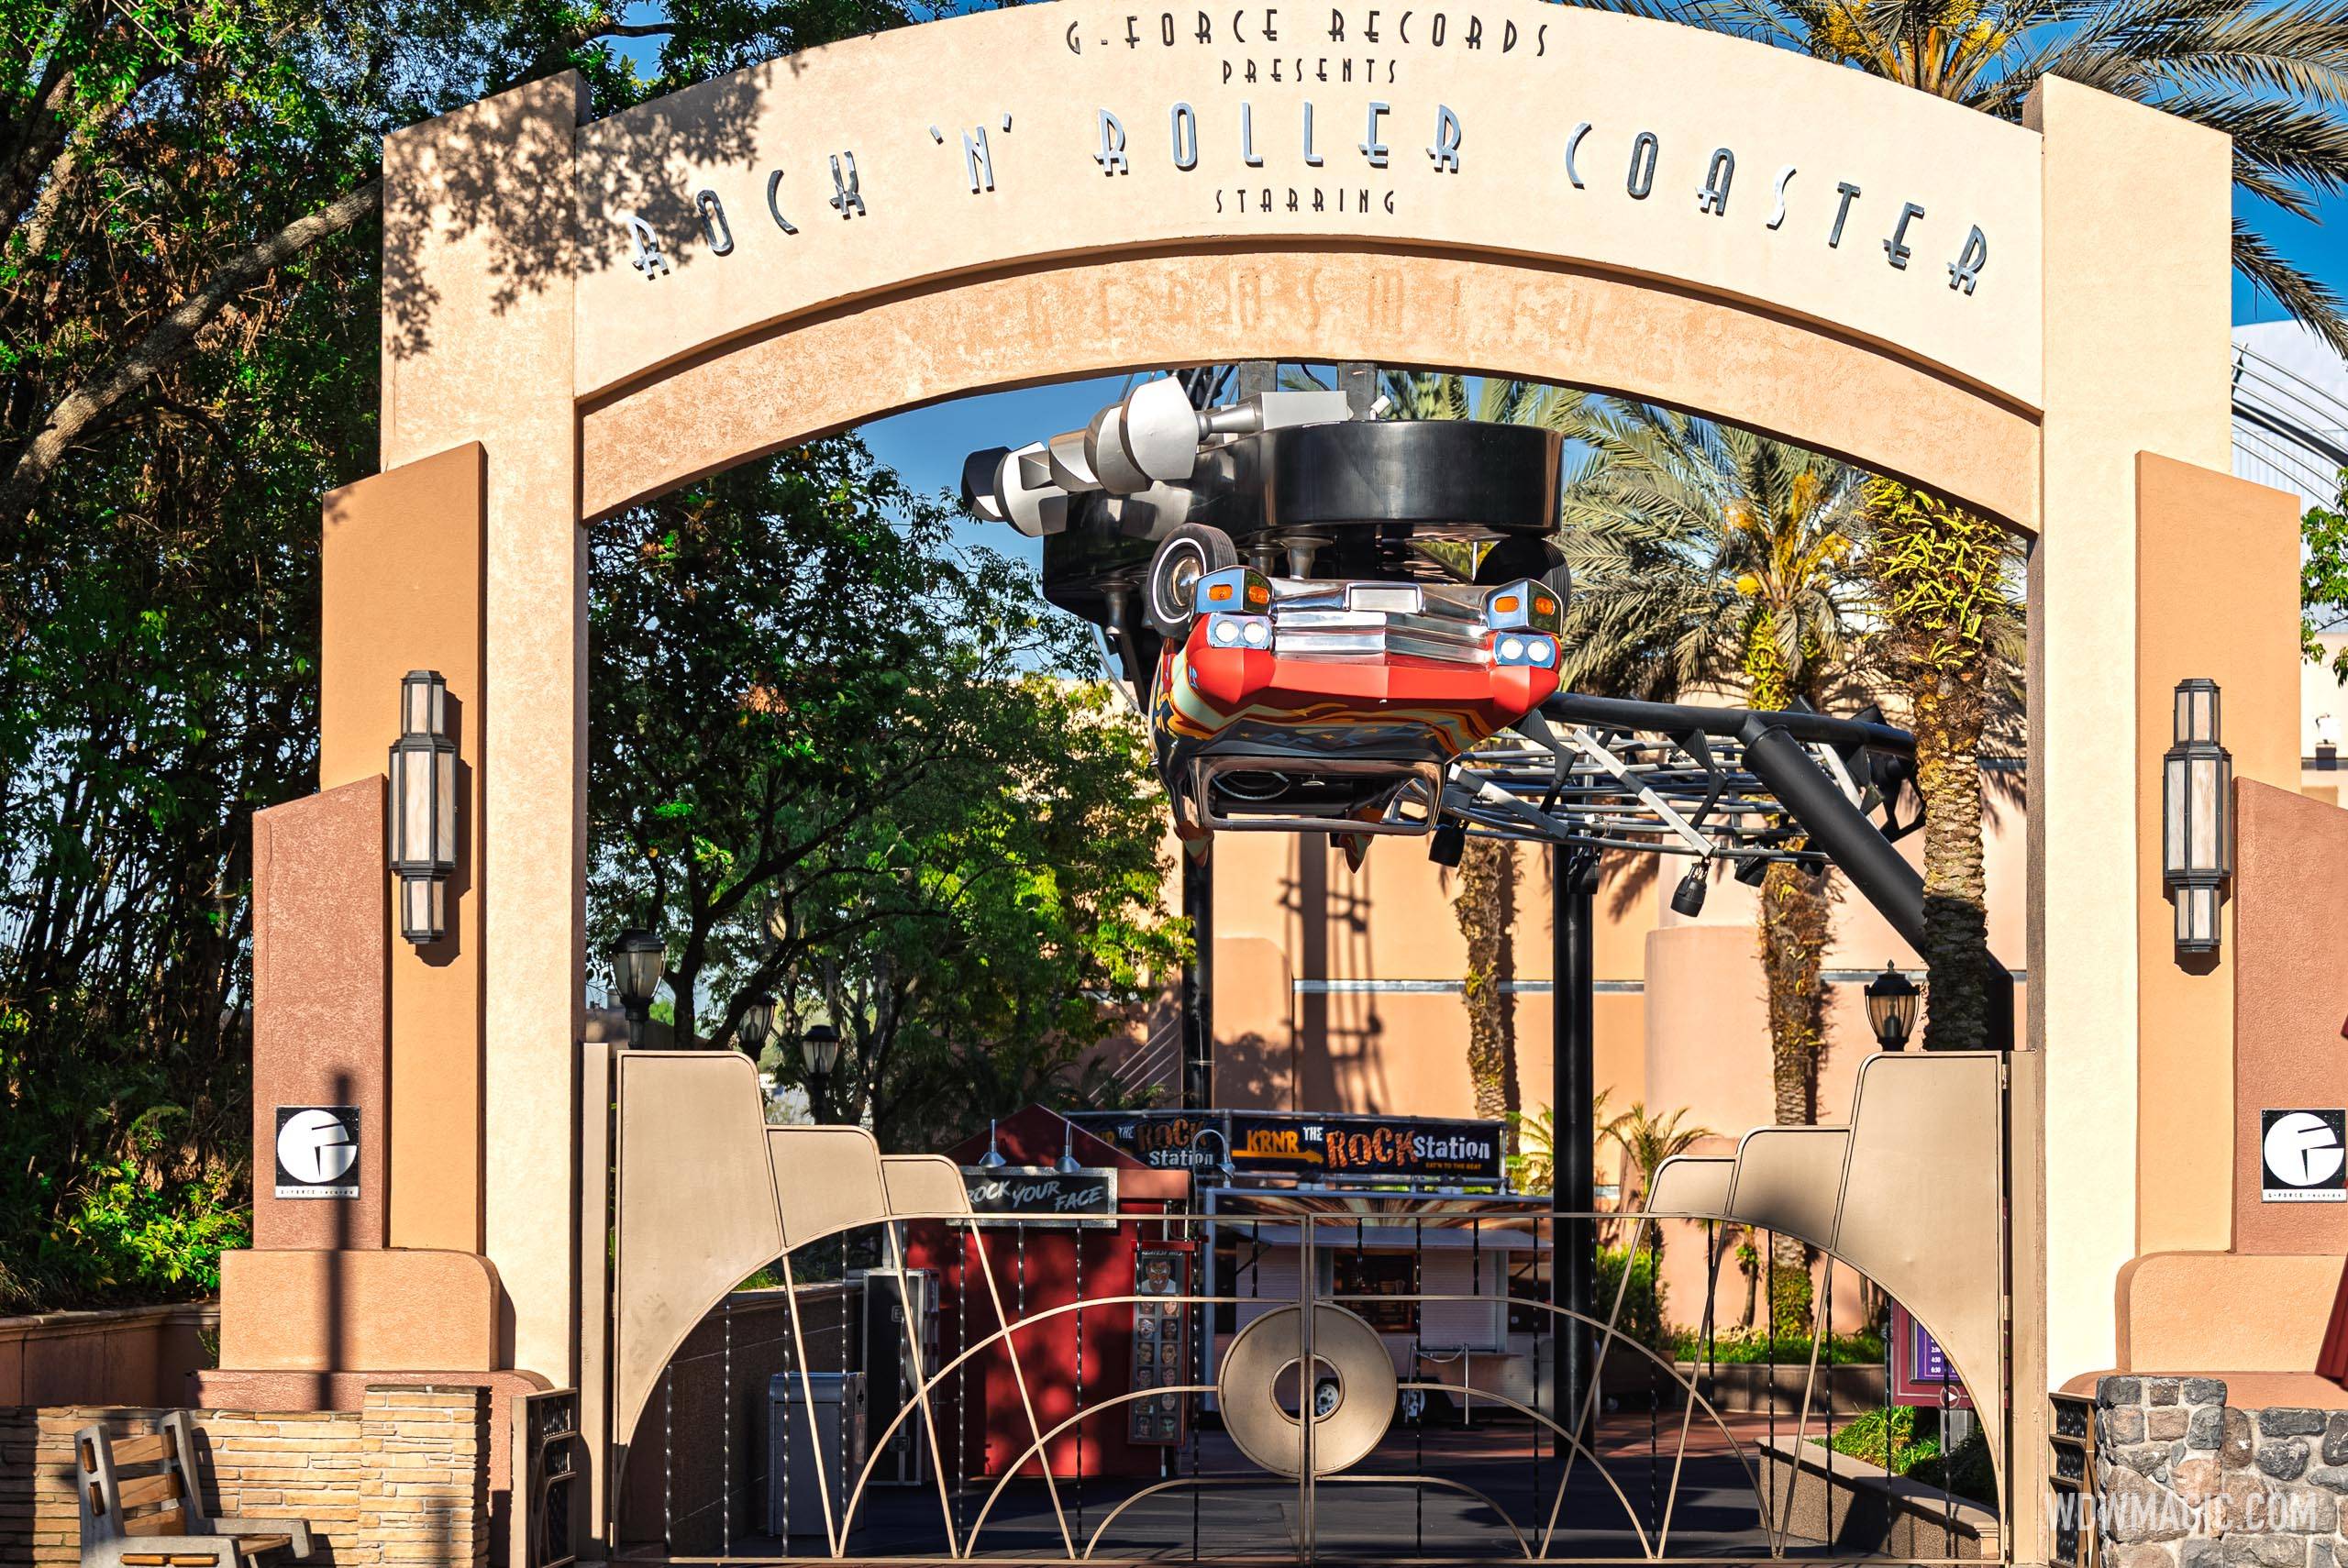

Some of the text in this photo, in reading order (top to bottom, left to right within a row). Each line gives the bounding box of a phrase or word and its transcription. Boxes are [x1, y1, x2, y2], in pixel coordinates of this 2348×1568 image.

[1067, 7, 1548, 56] G-FORCE RECORDS
[1223, 58, 1397, 84] PRESENTS
[627, 150, 867, 281] ROCK
[1093, 101, 1462, 176] ROLLER
[1565, 121, 1988, 295] COASTER
[1216, 188, 1396, 215] STARRING
[1117, 1125, 1135, 1139] THE
[1135, 1118, 1208, 1152] ROCK
[1246, 1126, 1490, 1169] KRNR THE ROCK Station
[1148, 1149, 1213, 1167] Station
[1013, 1180, 1060, 1209] YOUR
[1055, 1186, 1104, 1211] FACE
